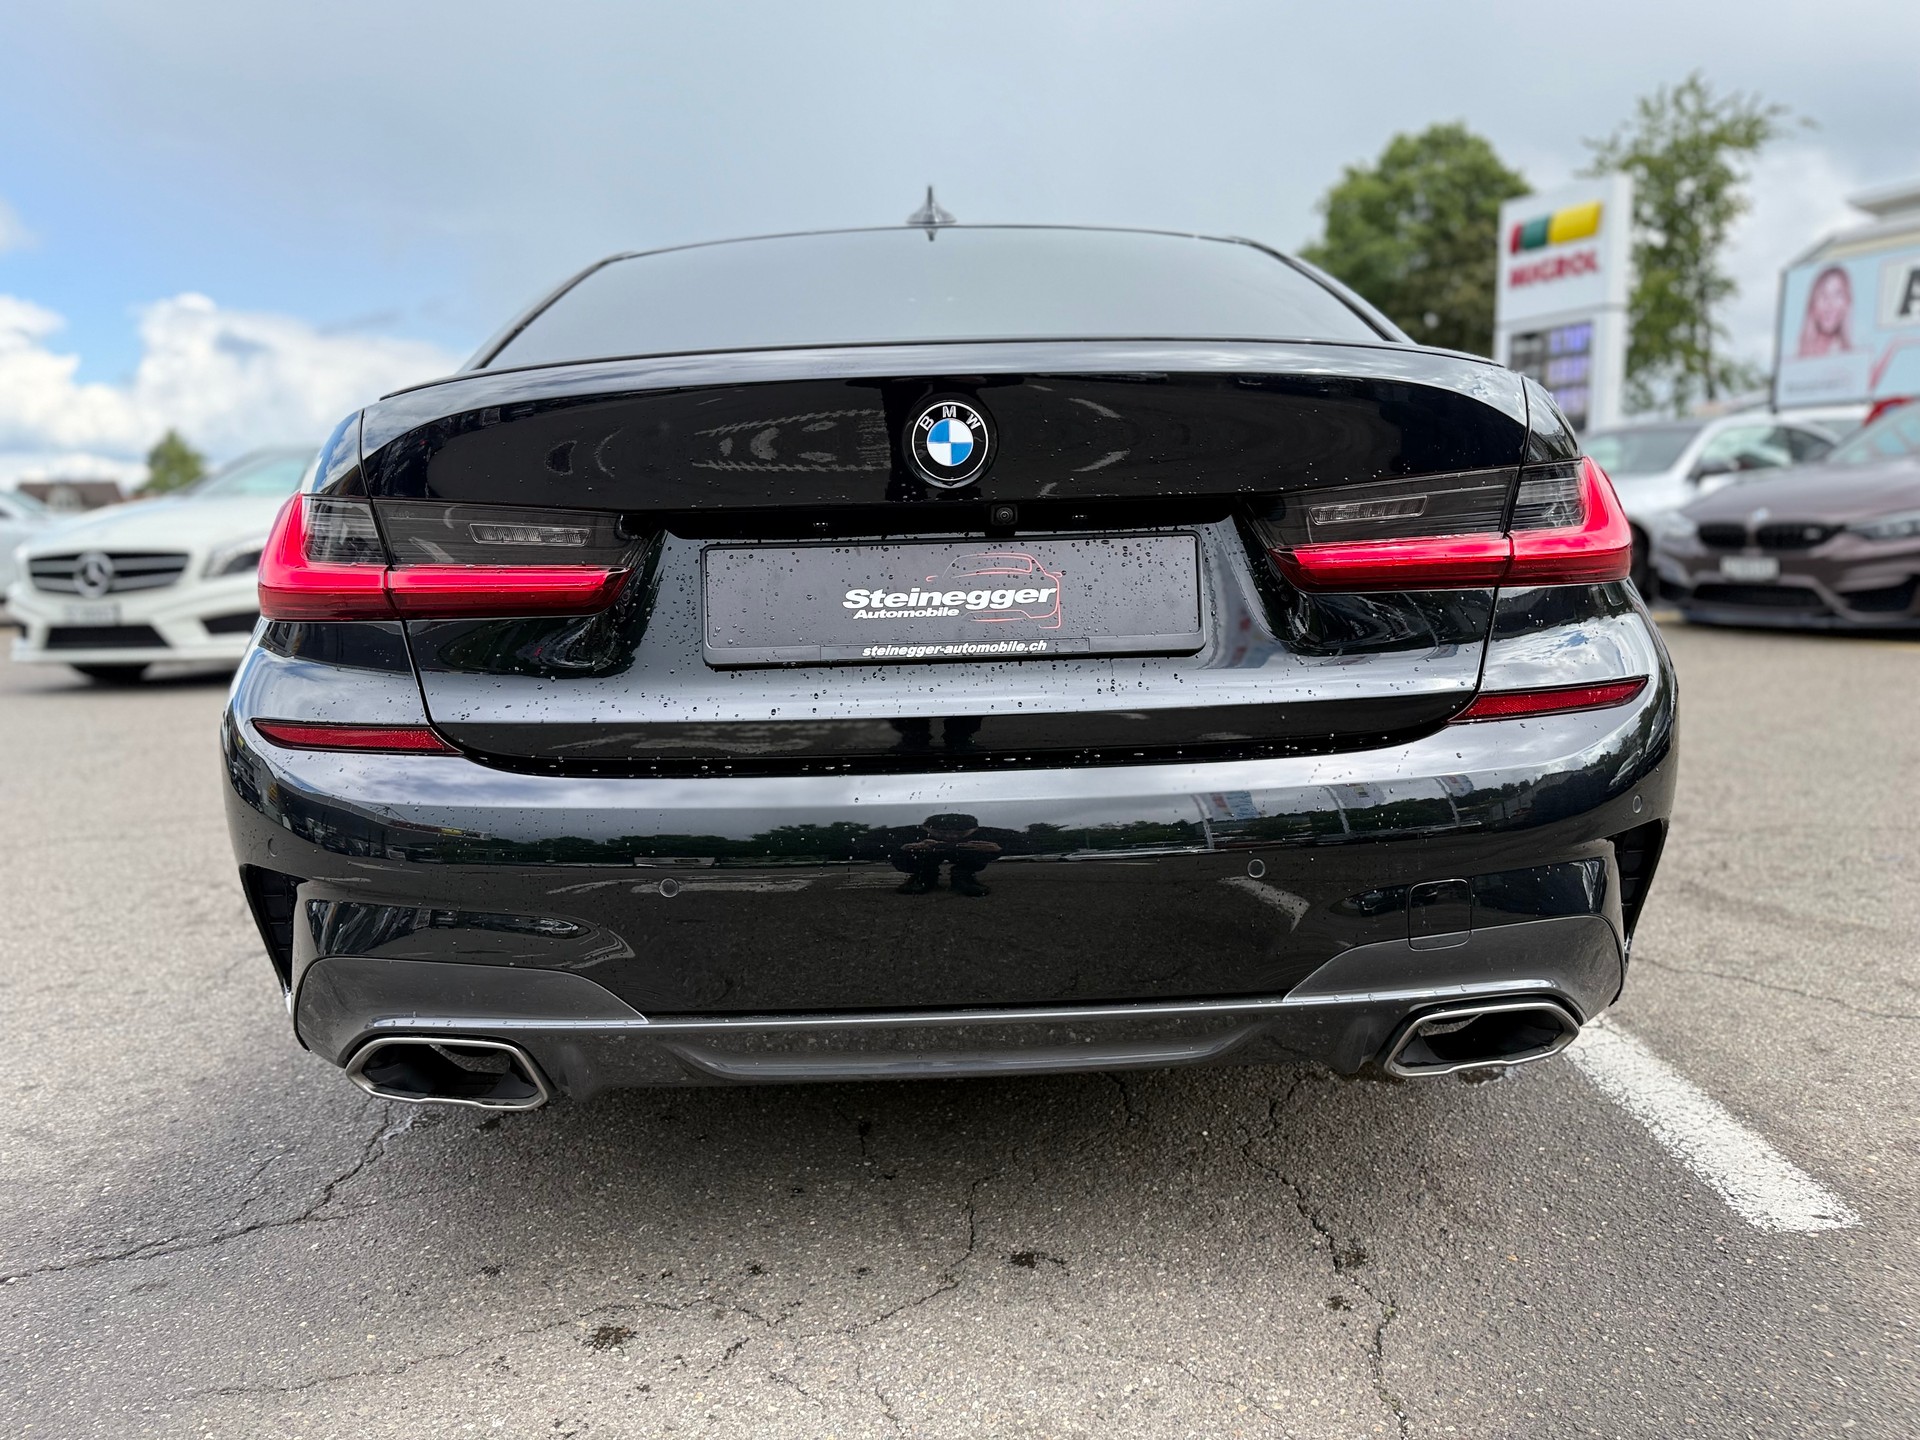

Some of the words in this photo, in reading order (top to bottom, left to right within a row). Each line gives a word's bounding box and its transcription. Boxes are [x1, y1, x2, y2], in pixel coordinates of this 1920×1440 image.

[919, 405, 981, 431] BMW
[842, 587, 1057, 610] Steinegger
[853, 606, 960, 619] Automobile
[862, 640, 1047, 657] steinegger-automobile.ch
